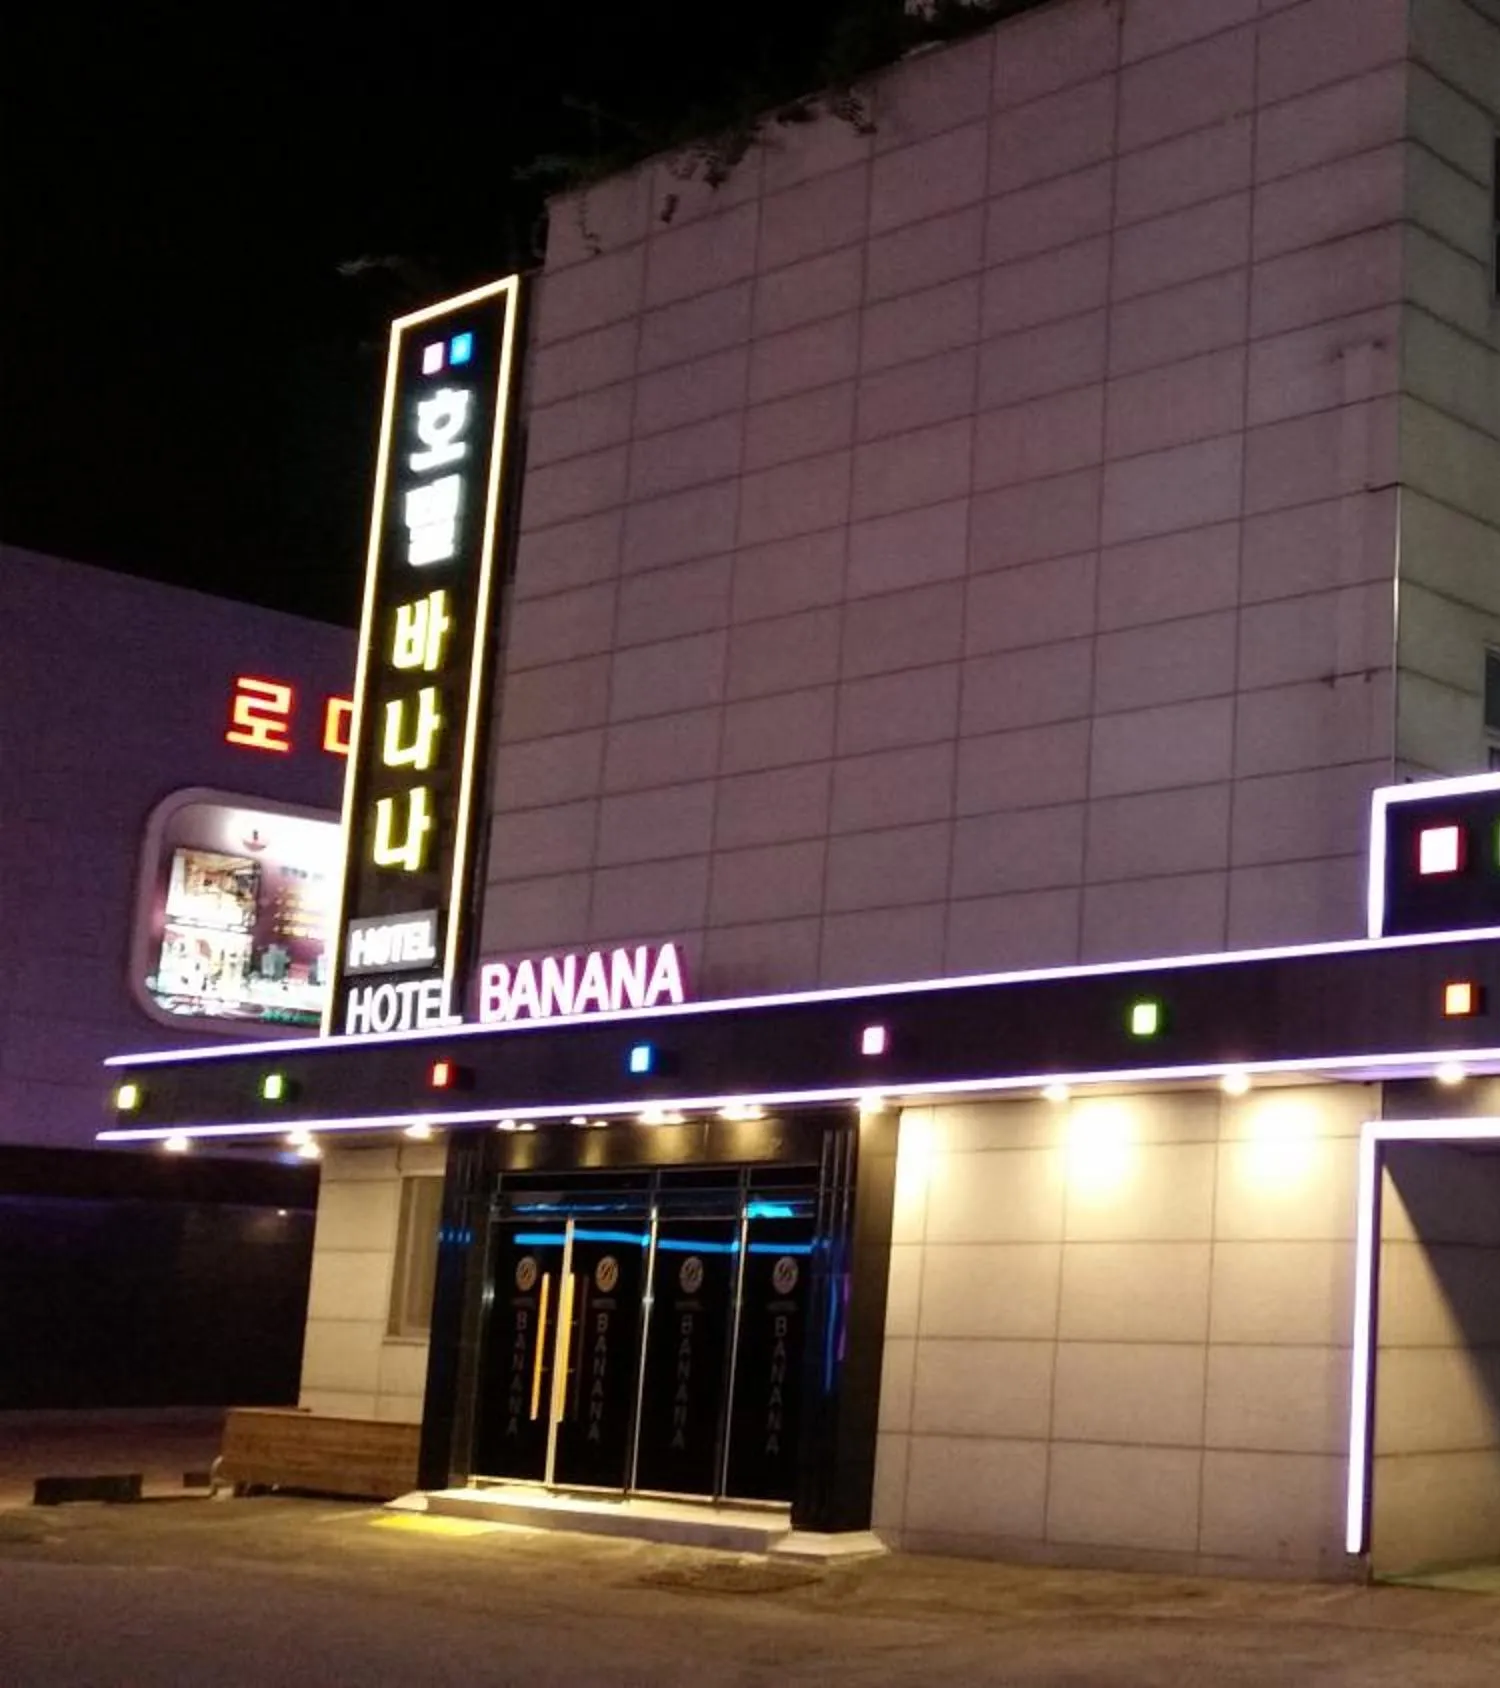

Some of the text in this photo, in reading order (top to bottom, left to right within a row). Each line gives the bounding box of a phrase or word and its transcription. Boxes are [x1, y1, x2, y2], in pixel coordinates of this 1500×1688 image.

[373, 589, 450, 871] 바나나
[346, 942, 684, 1035] HOTEL BANANA
[349, 920, 435, 967] HOTEL
